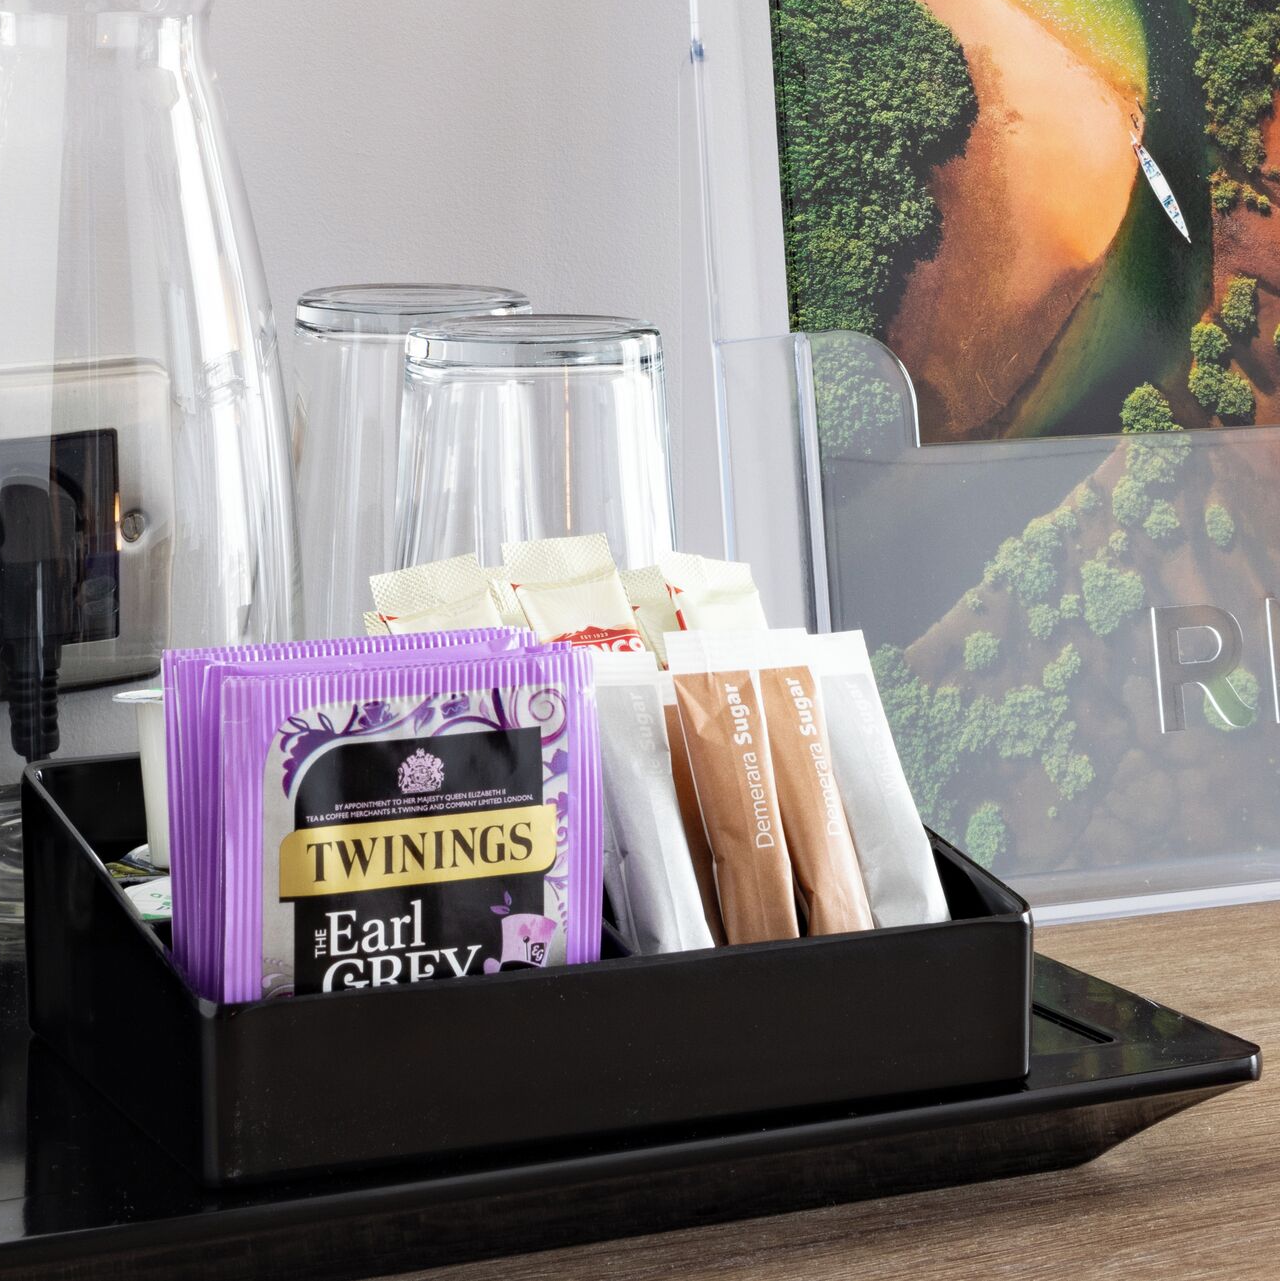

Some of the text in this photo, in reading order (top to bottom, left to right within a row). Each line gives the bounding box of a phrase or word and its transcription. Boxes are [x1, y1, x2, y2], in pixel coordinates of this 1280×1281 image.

[725, 683, 775, 848] Demerara Sugar
[786, 677, 843, 836] Demerara Sugar
[306, 814, 319, 823] TEA
[325, 811, 349, 821] COFFEE
[350, 808, 391, 819] MERCHANTS
[397, 804, 429, 815] TWINING
[430, 802, 445, 811] AND
[445, 799, 478, 811] COMPANY
[334, 803, 344, 811] BY
[344, 798, 391, 810] APPOINTMENT
[392, 797, 402, 805] TO
[403, 795, 416, 805] HER
[417, 793, 444, 804] MAJESTY
[445, 791, 468, 801] QUEEN
[468, 788, 500, 799] ELIZABETH
[307, 823, 533, 882] TWININGS
[314, 928, 327, 958] THE
[325, 899, 426, 956] Earl
